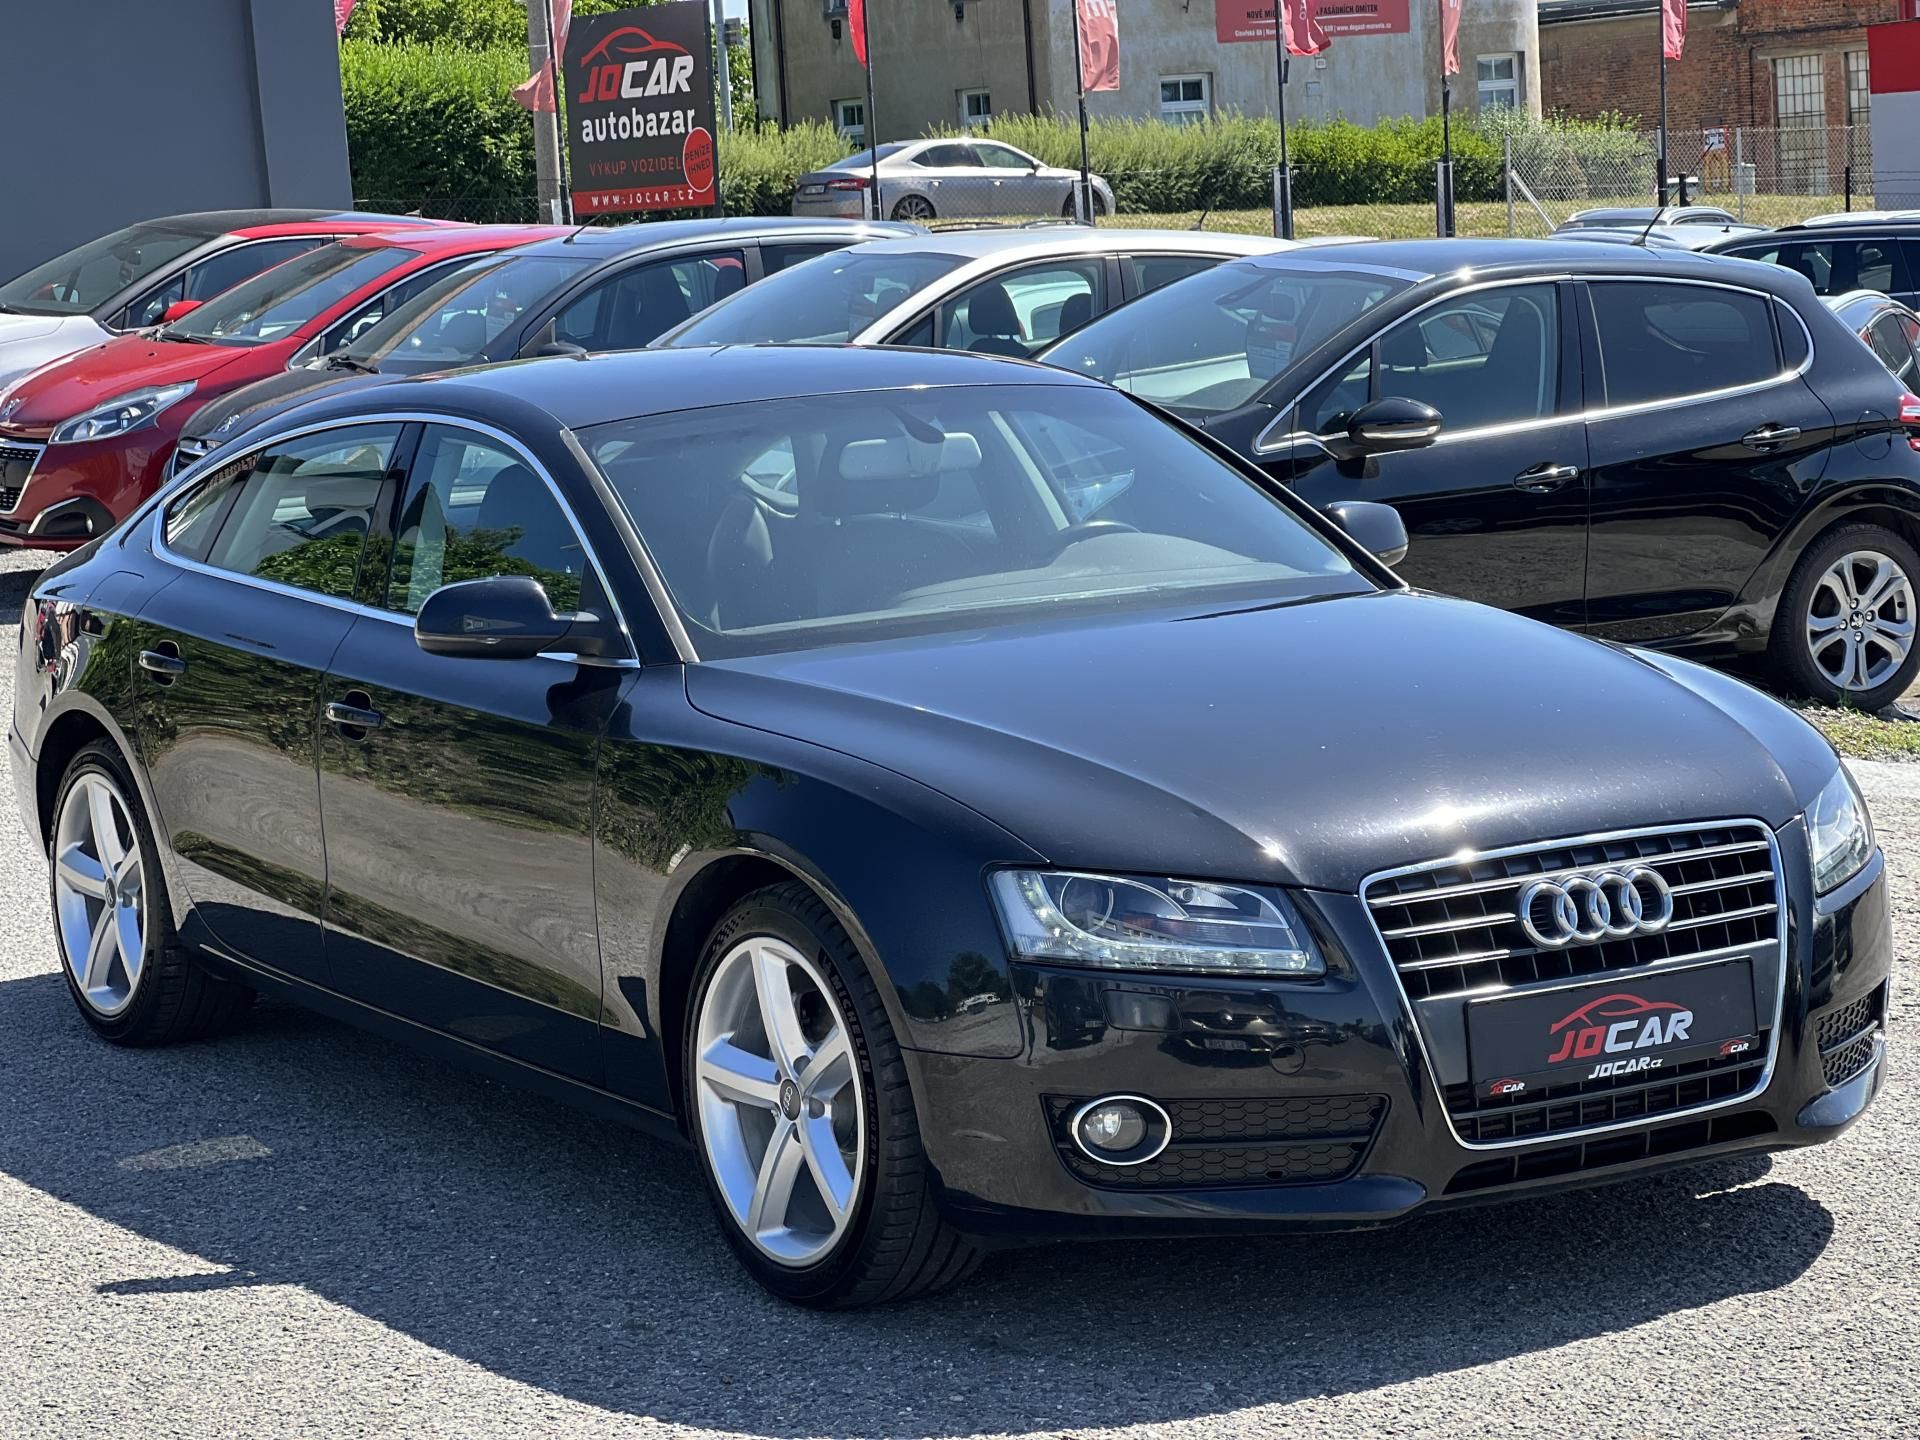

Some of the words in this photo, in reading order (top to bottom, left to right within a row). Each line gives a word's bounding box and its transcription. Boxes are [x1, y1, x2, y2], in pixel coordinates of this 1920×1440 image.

[579, 54, 694, 104] JOCAR
[582, 107, 695, 143] autobazar
[589, 158, 627, 177] VÝKUP
[631, 156, 682, 174] VOZIDEL
[688, 158, 711, 175] IHNED
[831, 973, 872, 1073] MICHELIN
[1548, 1010, 1694, 1063] JOCAR
[1720, 1042, 1749, 1056] JOCAR
[1490, 1081, 1525, 1095] JOCAR
